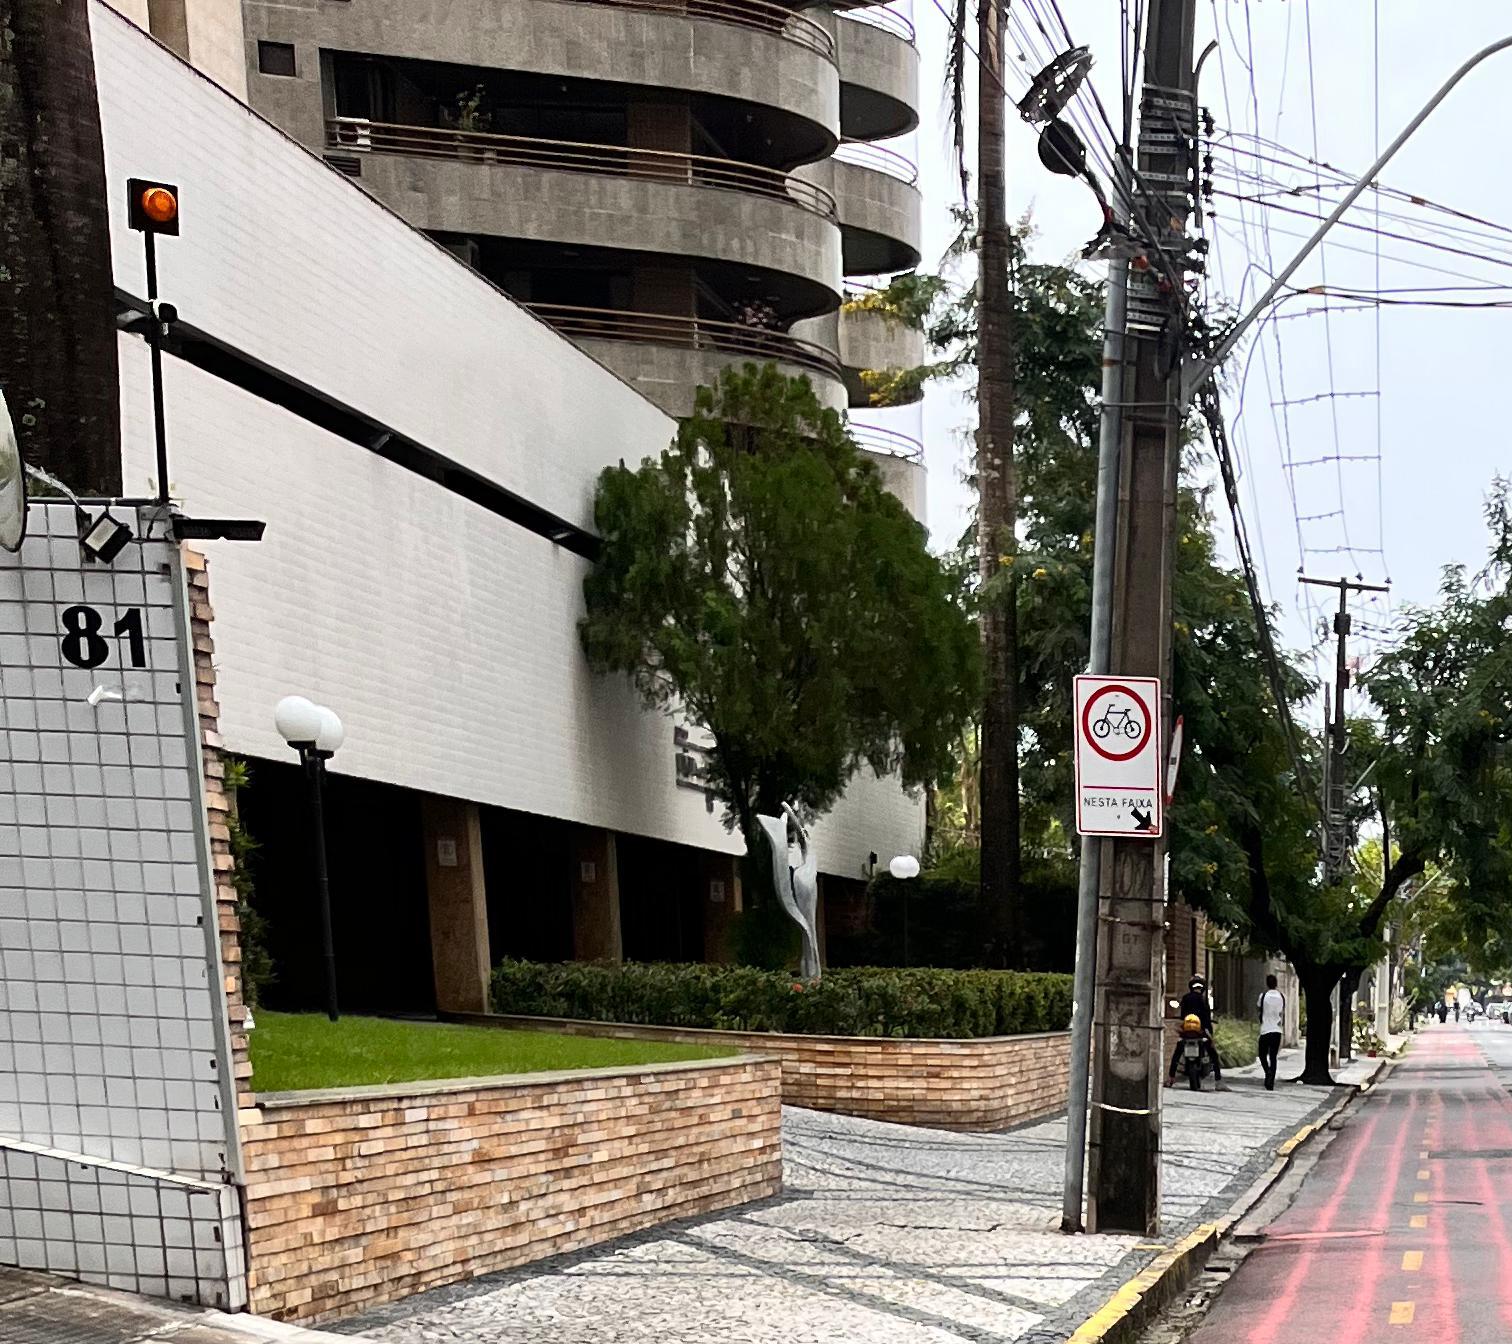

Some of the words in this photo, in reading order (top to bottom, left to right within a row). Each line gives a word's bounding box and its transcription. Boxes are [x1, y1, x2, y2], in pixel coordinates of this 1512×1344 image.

[61, 605, 146, 669] 81
[1084, 797, 1118, 807] NESTA
[1122, 798, 1153, 808] FAIXA
